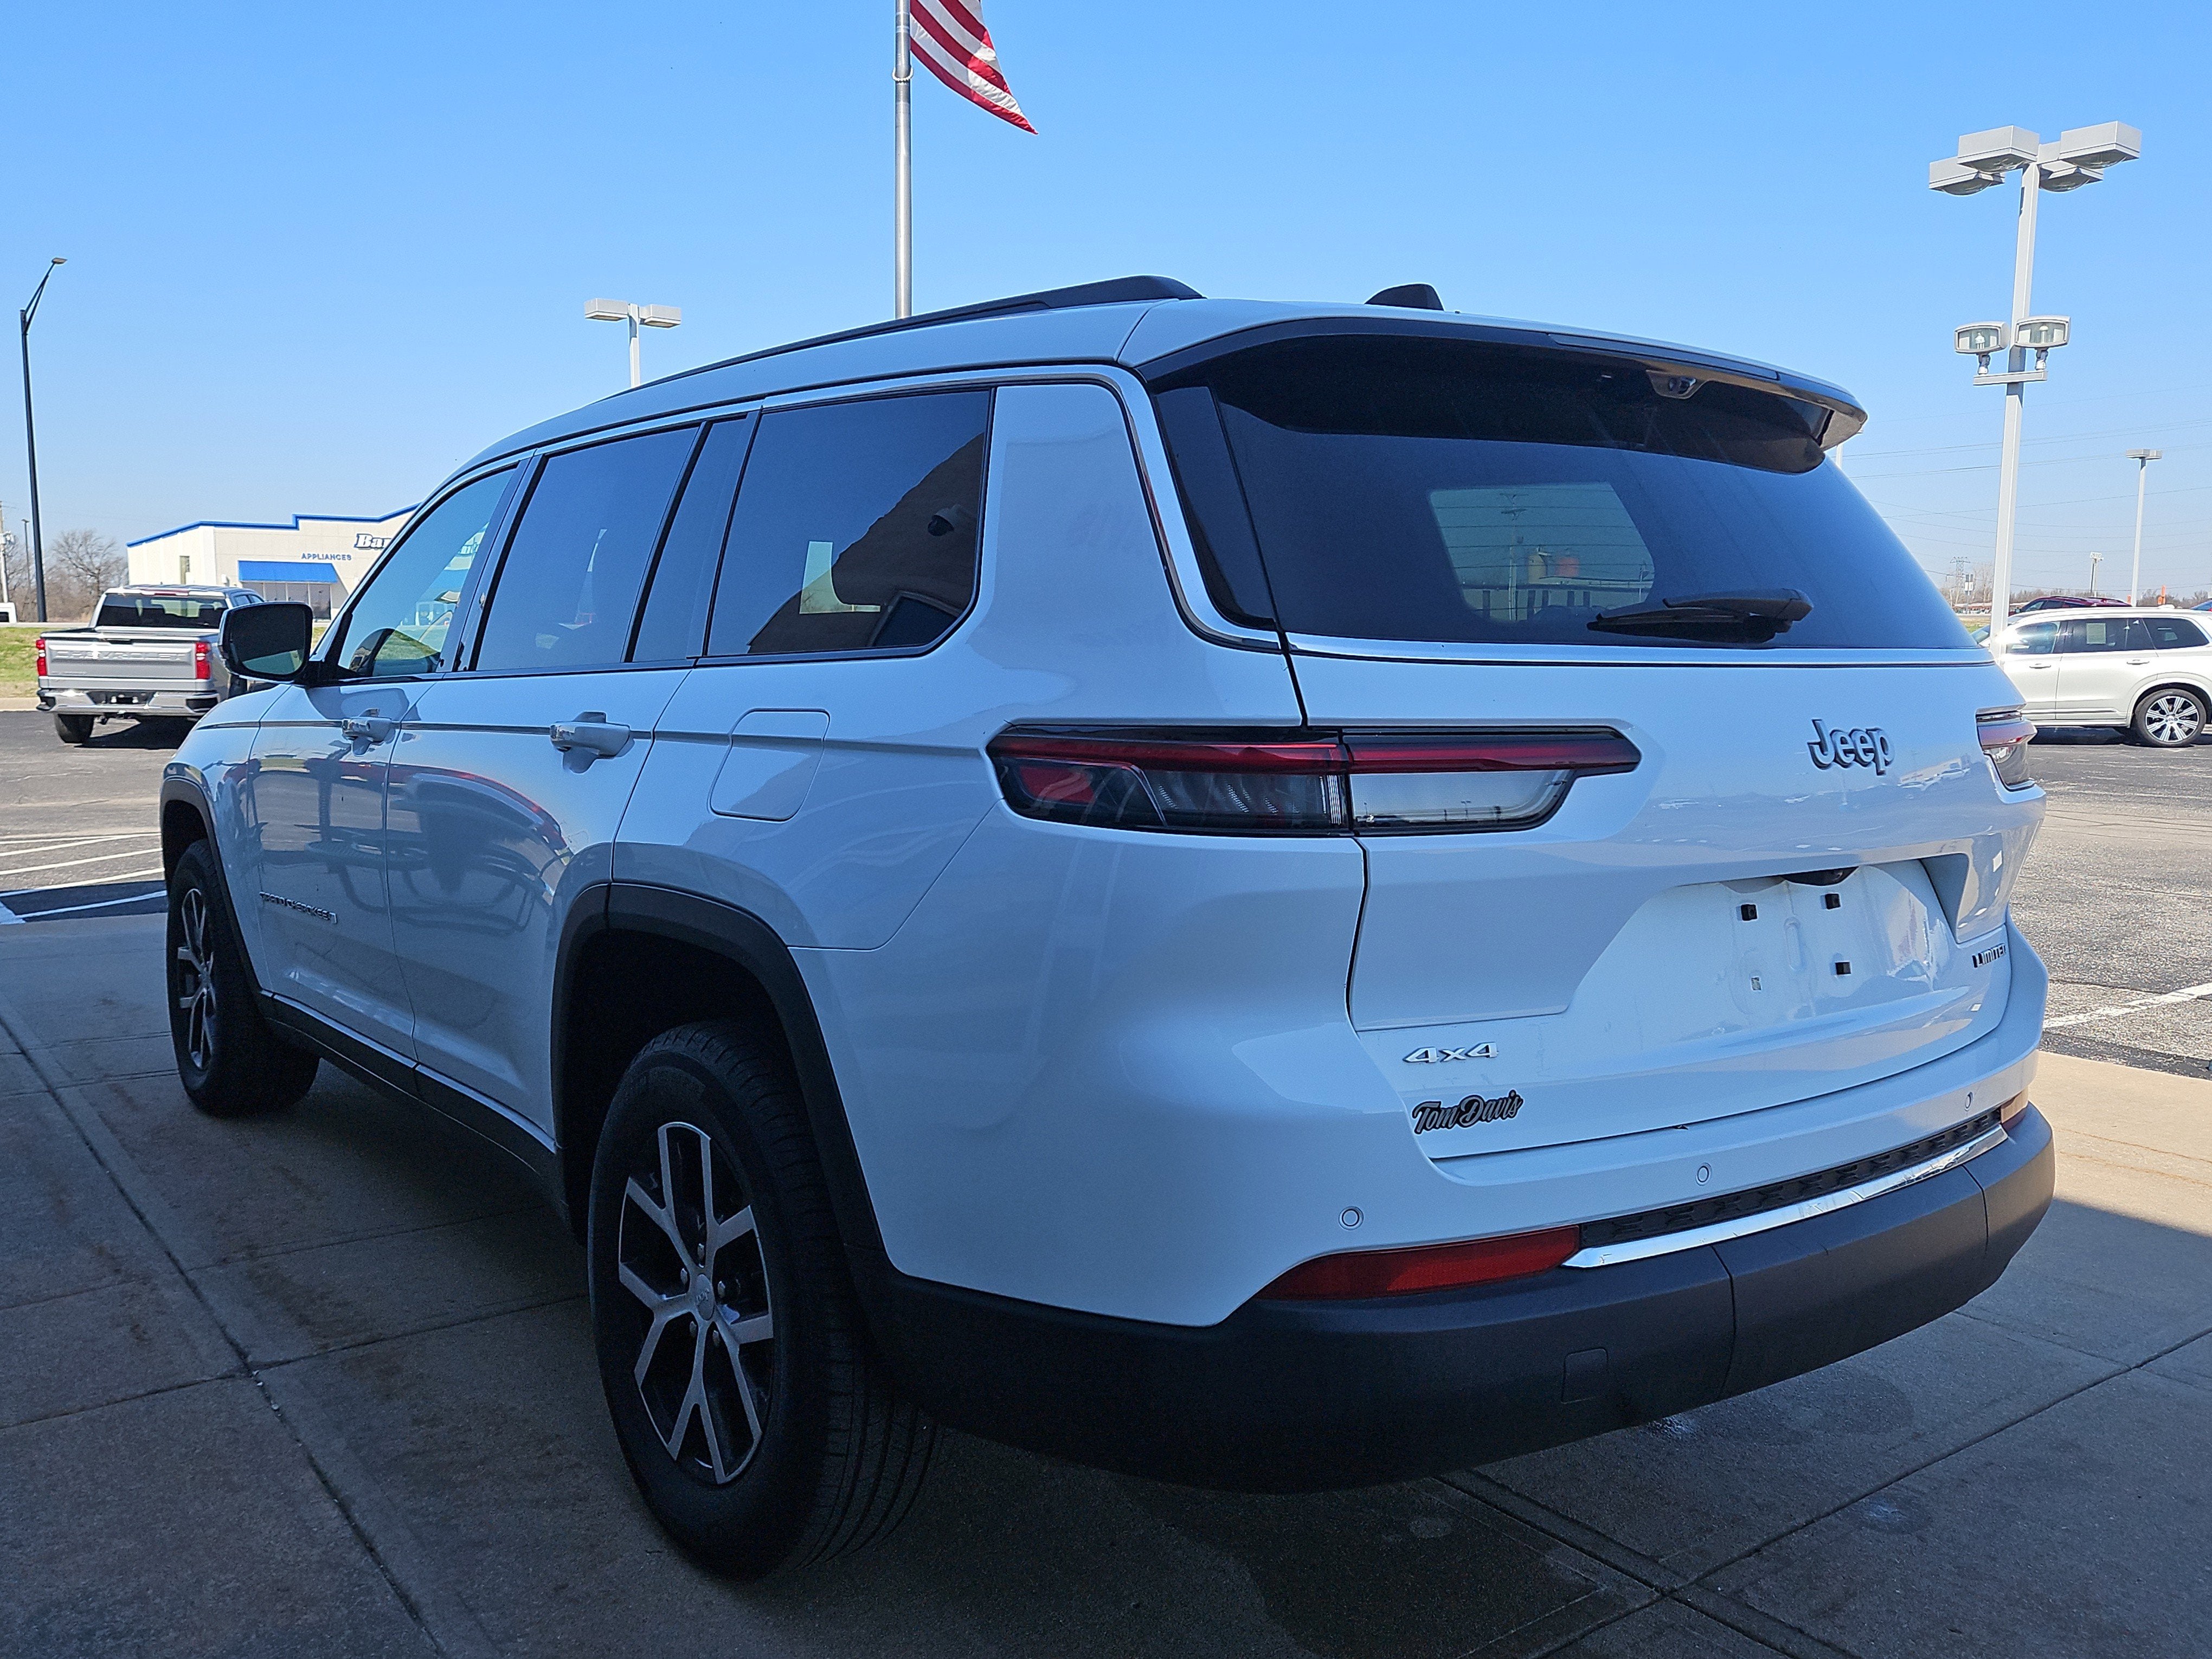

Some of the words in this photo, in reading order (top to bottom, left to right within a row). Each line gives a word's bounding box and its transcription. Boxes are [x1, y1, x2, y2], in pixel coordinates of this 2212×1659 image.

[301, 552, 352, 561] APPLIANCES
[1807, 719, 1895, 775] Jeep
[1403, 1041, 1500, 1063] 4x4
[1412, 1101, 1460, 1134] Tom
[1457, 1089, 1524, 1128] Davis
